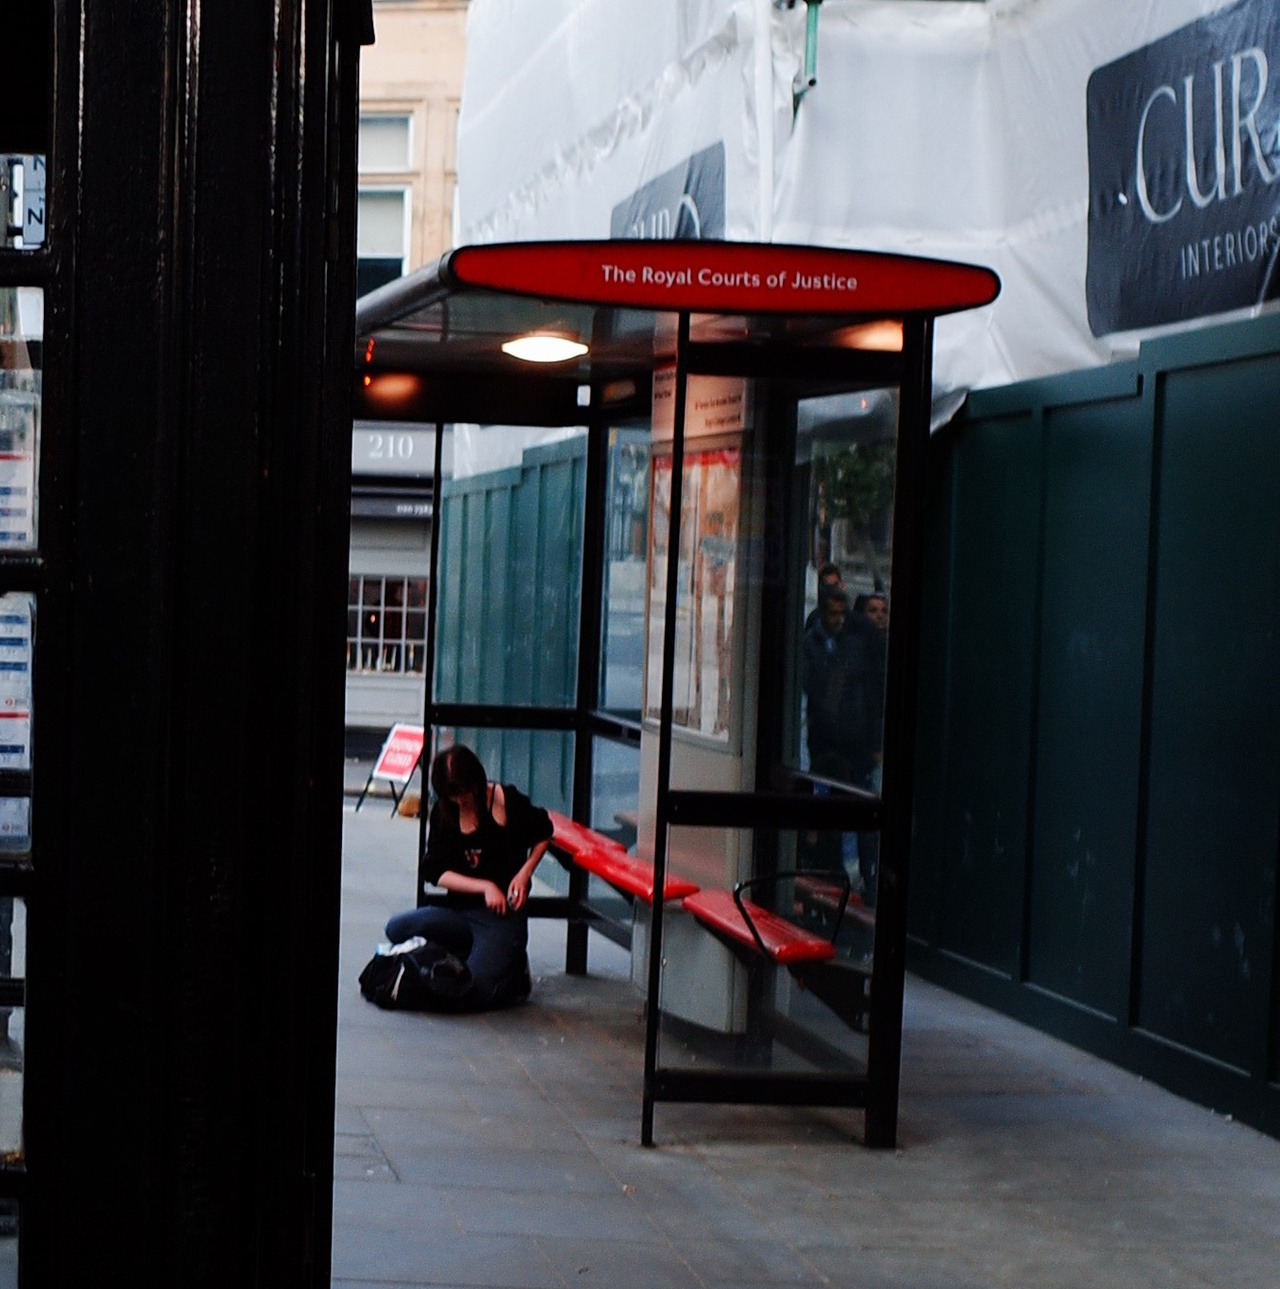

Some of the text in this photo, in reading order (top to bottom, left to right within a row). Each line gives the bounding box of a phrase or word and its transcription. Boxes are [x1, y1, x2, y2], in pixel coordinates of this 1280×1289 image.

[1136, 47, 1280, 224] CUR
[602, 265, 858, 290] The Royal Courts of Justice
[368, 434, 414, 459] 210
